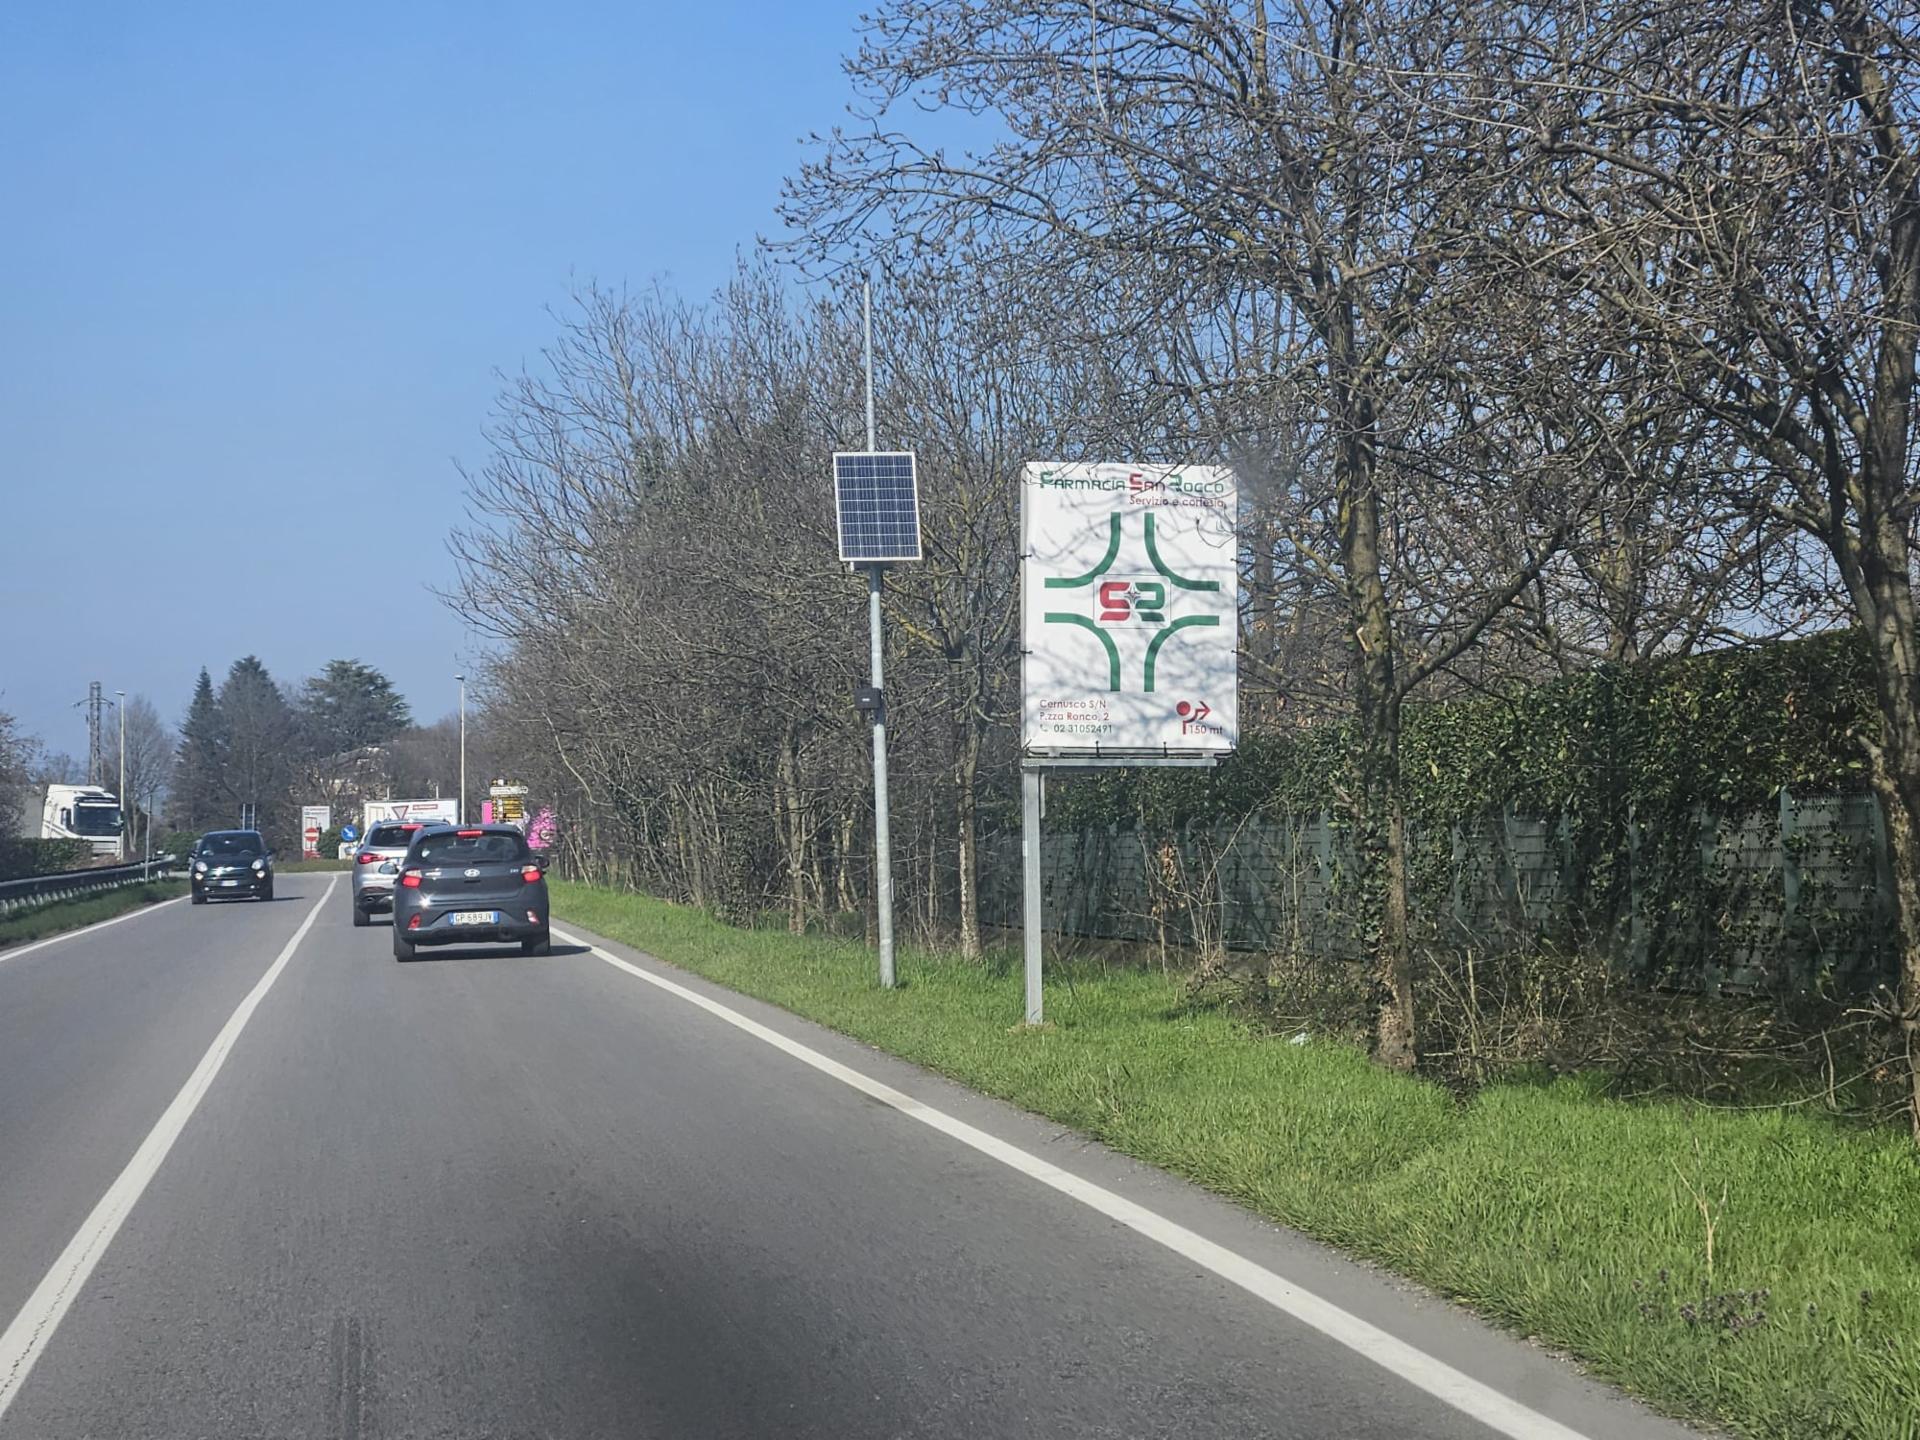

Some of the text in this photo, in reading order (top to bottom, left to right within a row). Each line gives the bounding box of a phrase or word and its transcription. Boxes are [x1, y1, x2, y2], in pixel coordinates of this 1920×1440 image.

[1129, 495, 1169, 506] Servizio
[1040, 699, 1107, 710] Cernusco S/N
[1040, 711, 1064, 721] P.zza
[1103, 712, 1110, 721] 2
[1189, 725, 1223, 735] 150 mt
